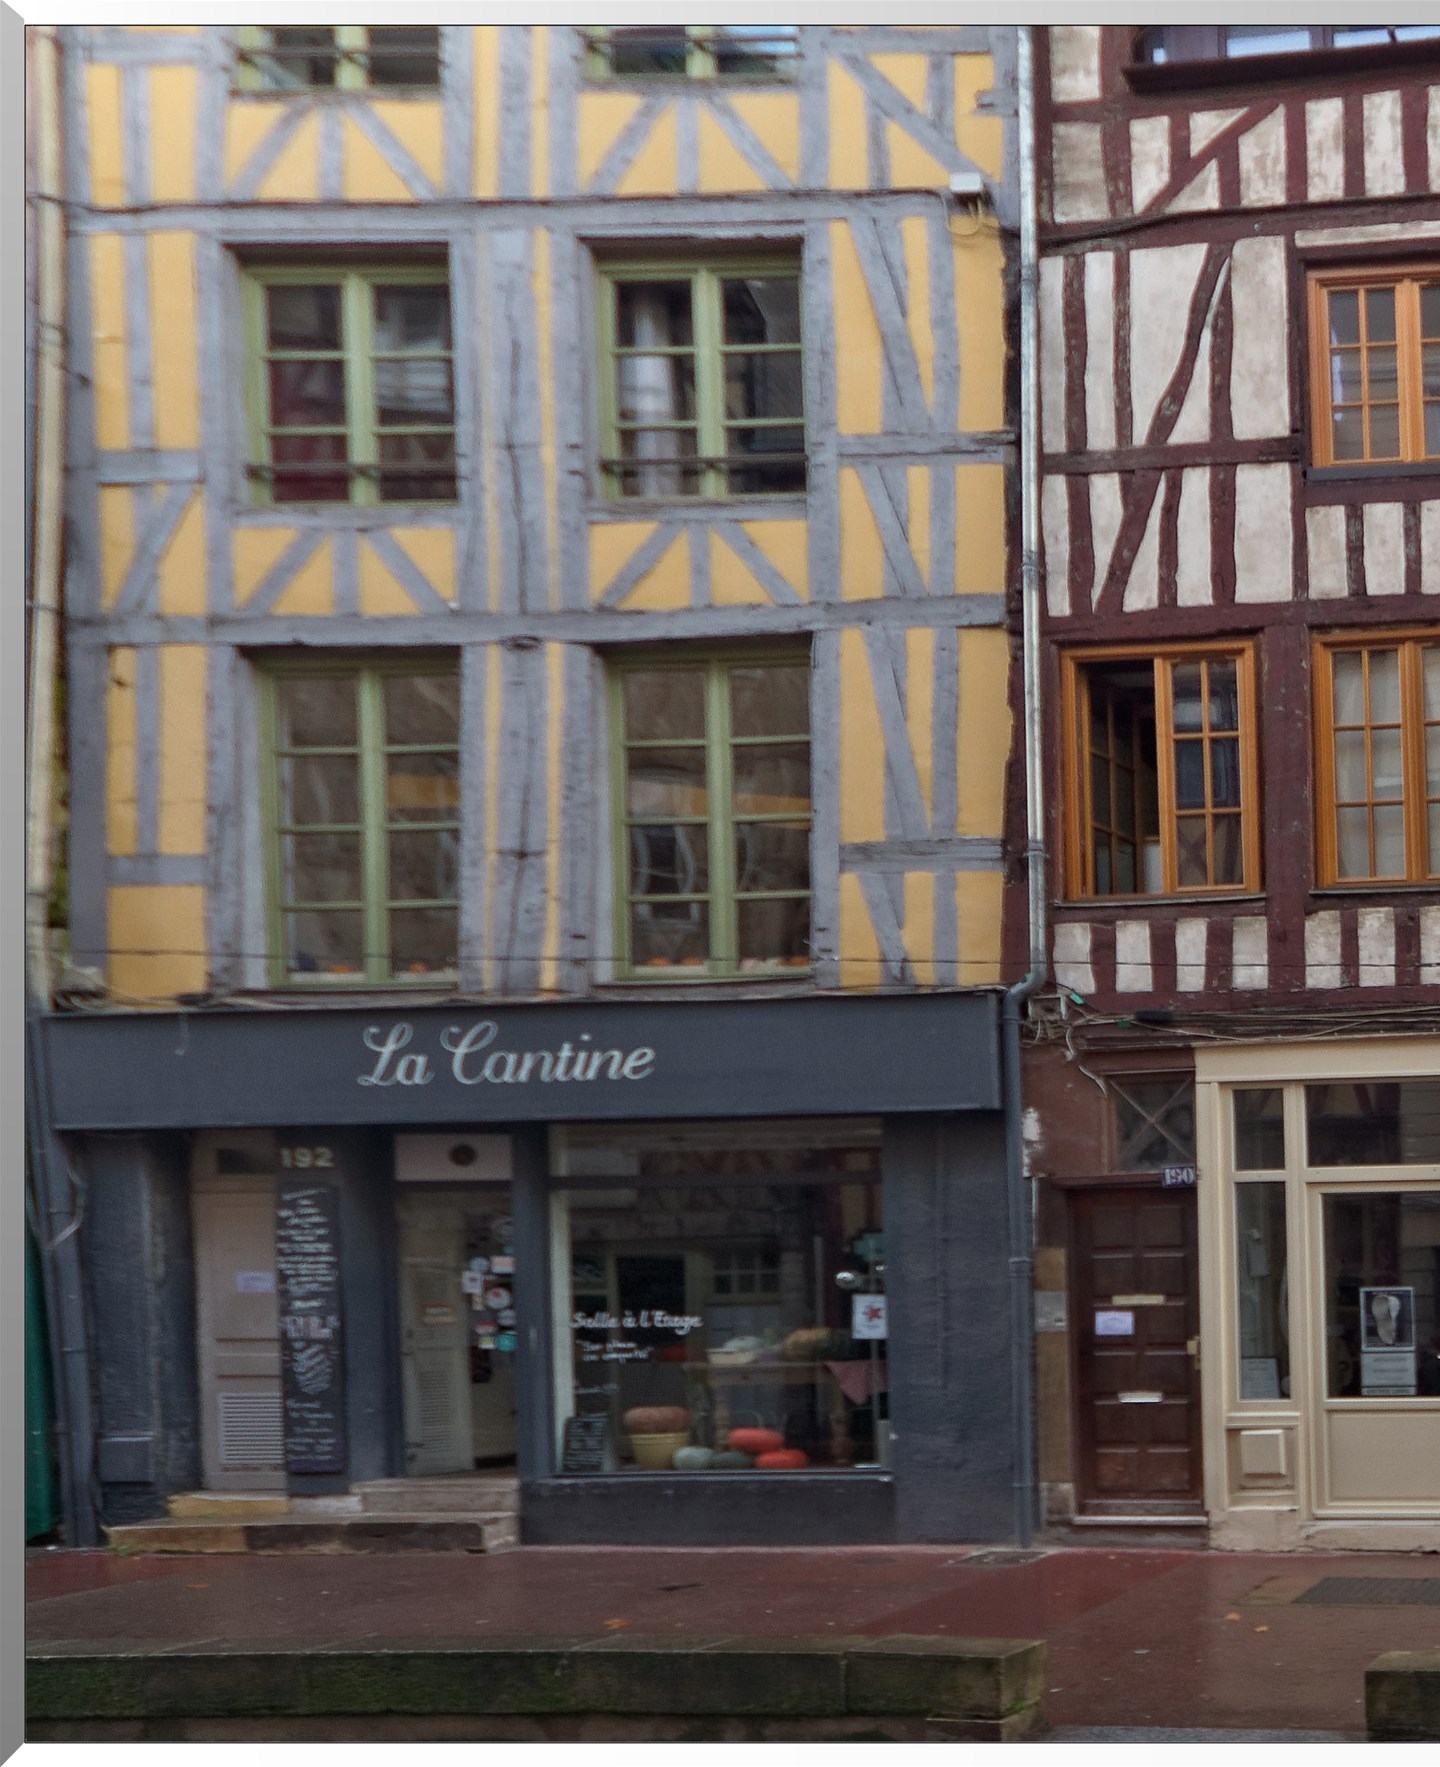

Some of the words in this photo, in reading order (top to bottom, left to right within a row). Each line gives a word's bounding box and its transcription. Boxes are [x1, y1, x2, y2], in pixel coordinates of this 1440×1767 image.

[357, 1021, 436, 1087] La
[440, 1019, 656, 1085] Cantine
[280, 1147, 334, 1168] 192
[1163, 1167, 1195, 1186] 190
